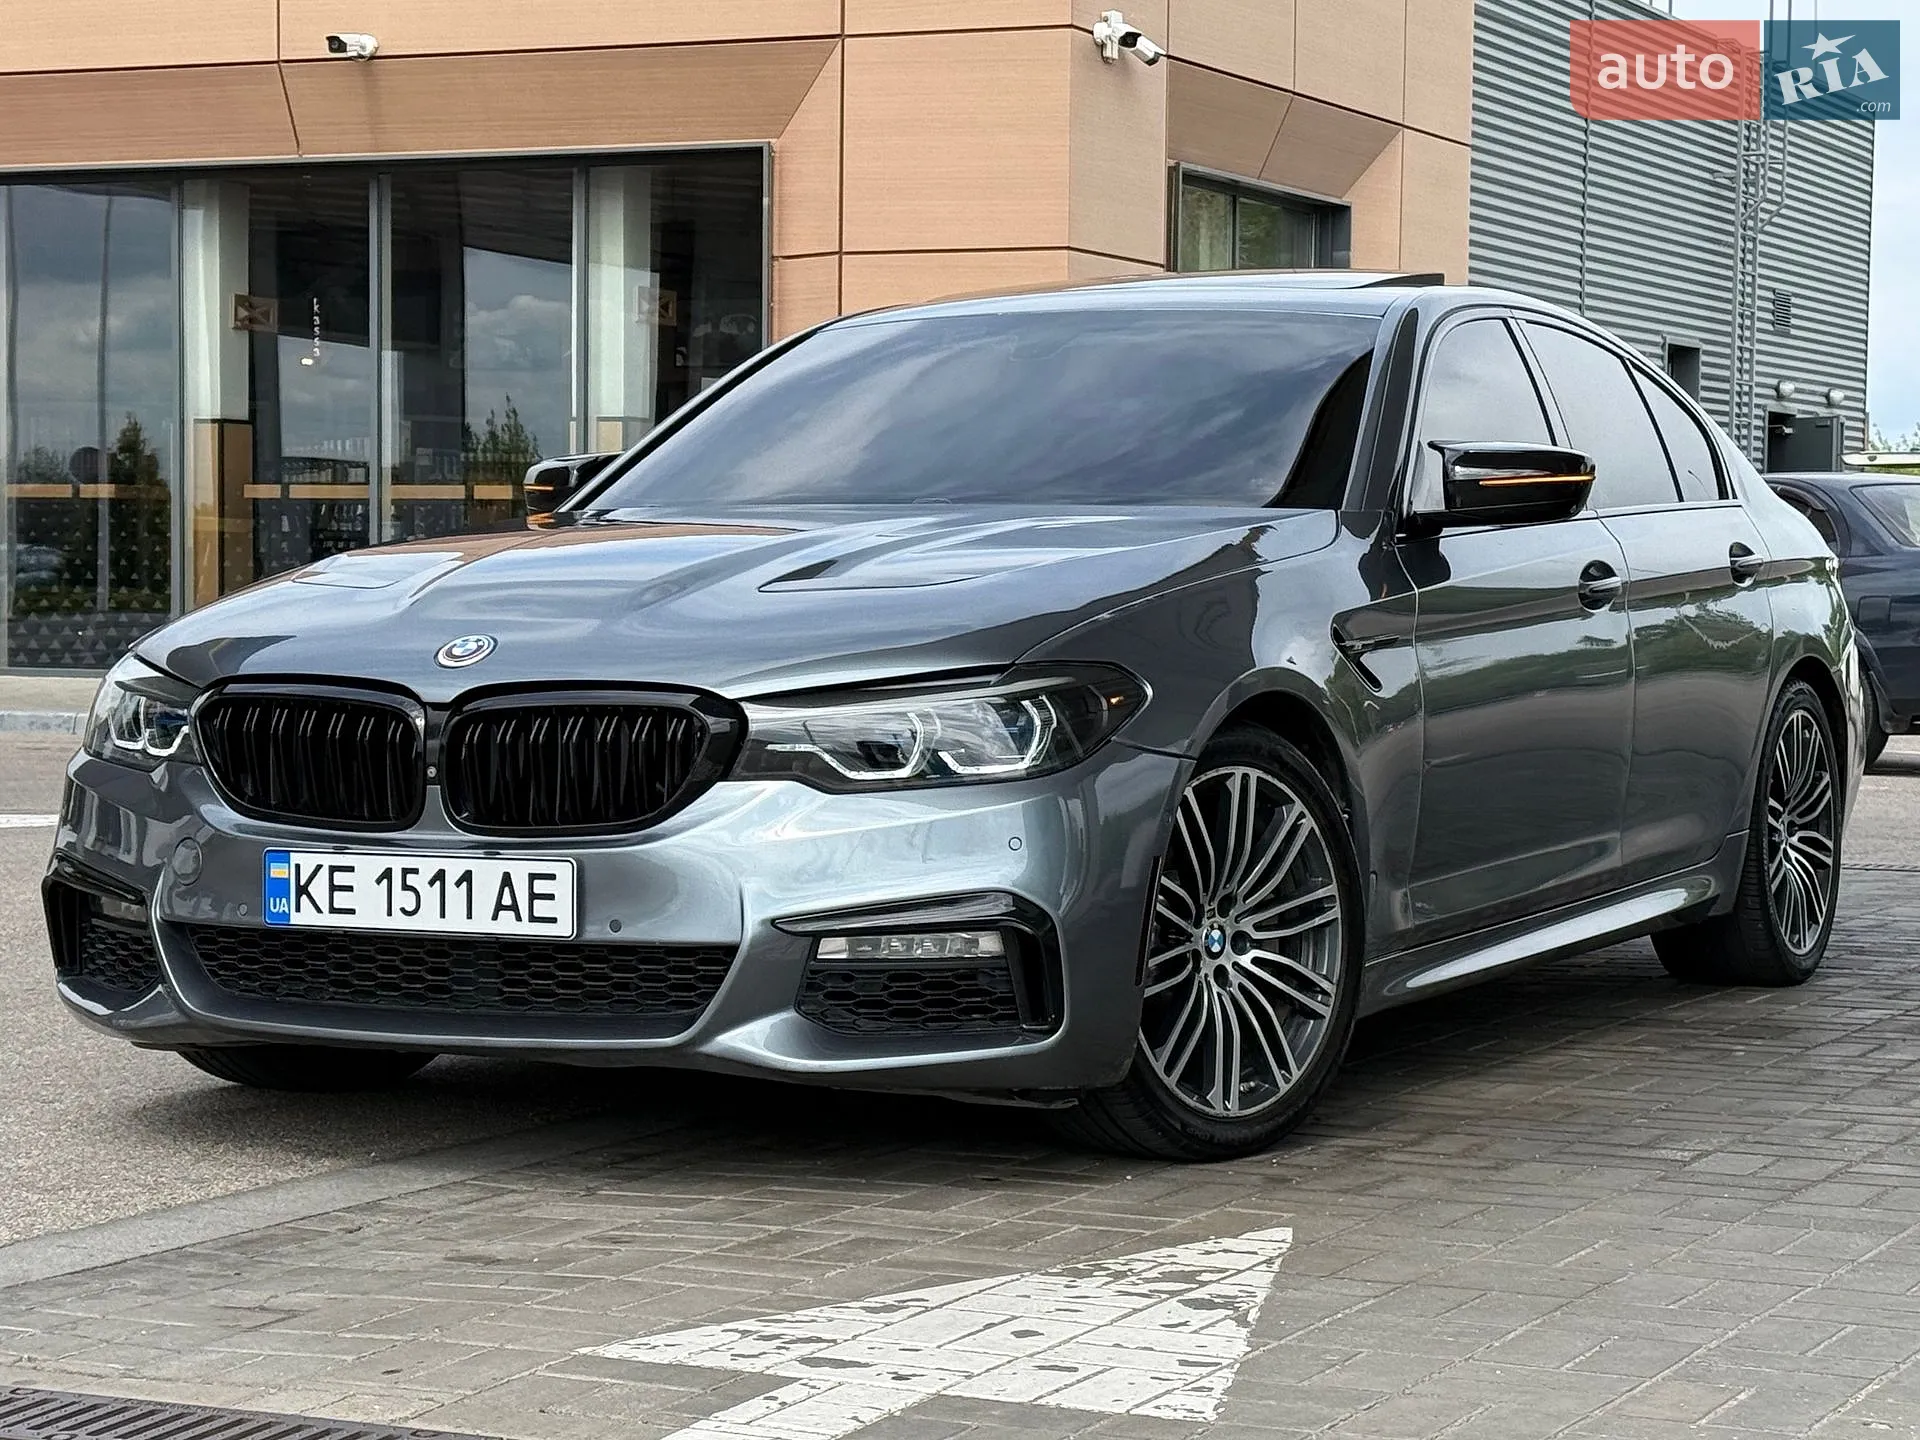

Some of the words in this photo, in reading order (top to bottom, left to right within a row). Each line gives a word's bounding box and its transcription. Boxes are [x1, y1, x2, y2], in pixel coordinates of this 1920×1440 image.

[269, 897, 290, 914] UA
[294, 862, 357, 916] KE
[374, 866, 474, 921] 1511
[490, 871, 559, 925] AE
